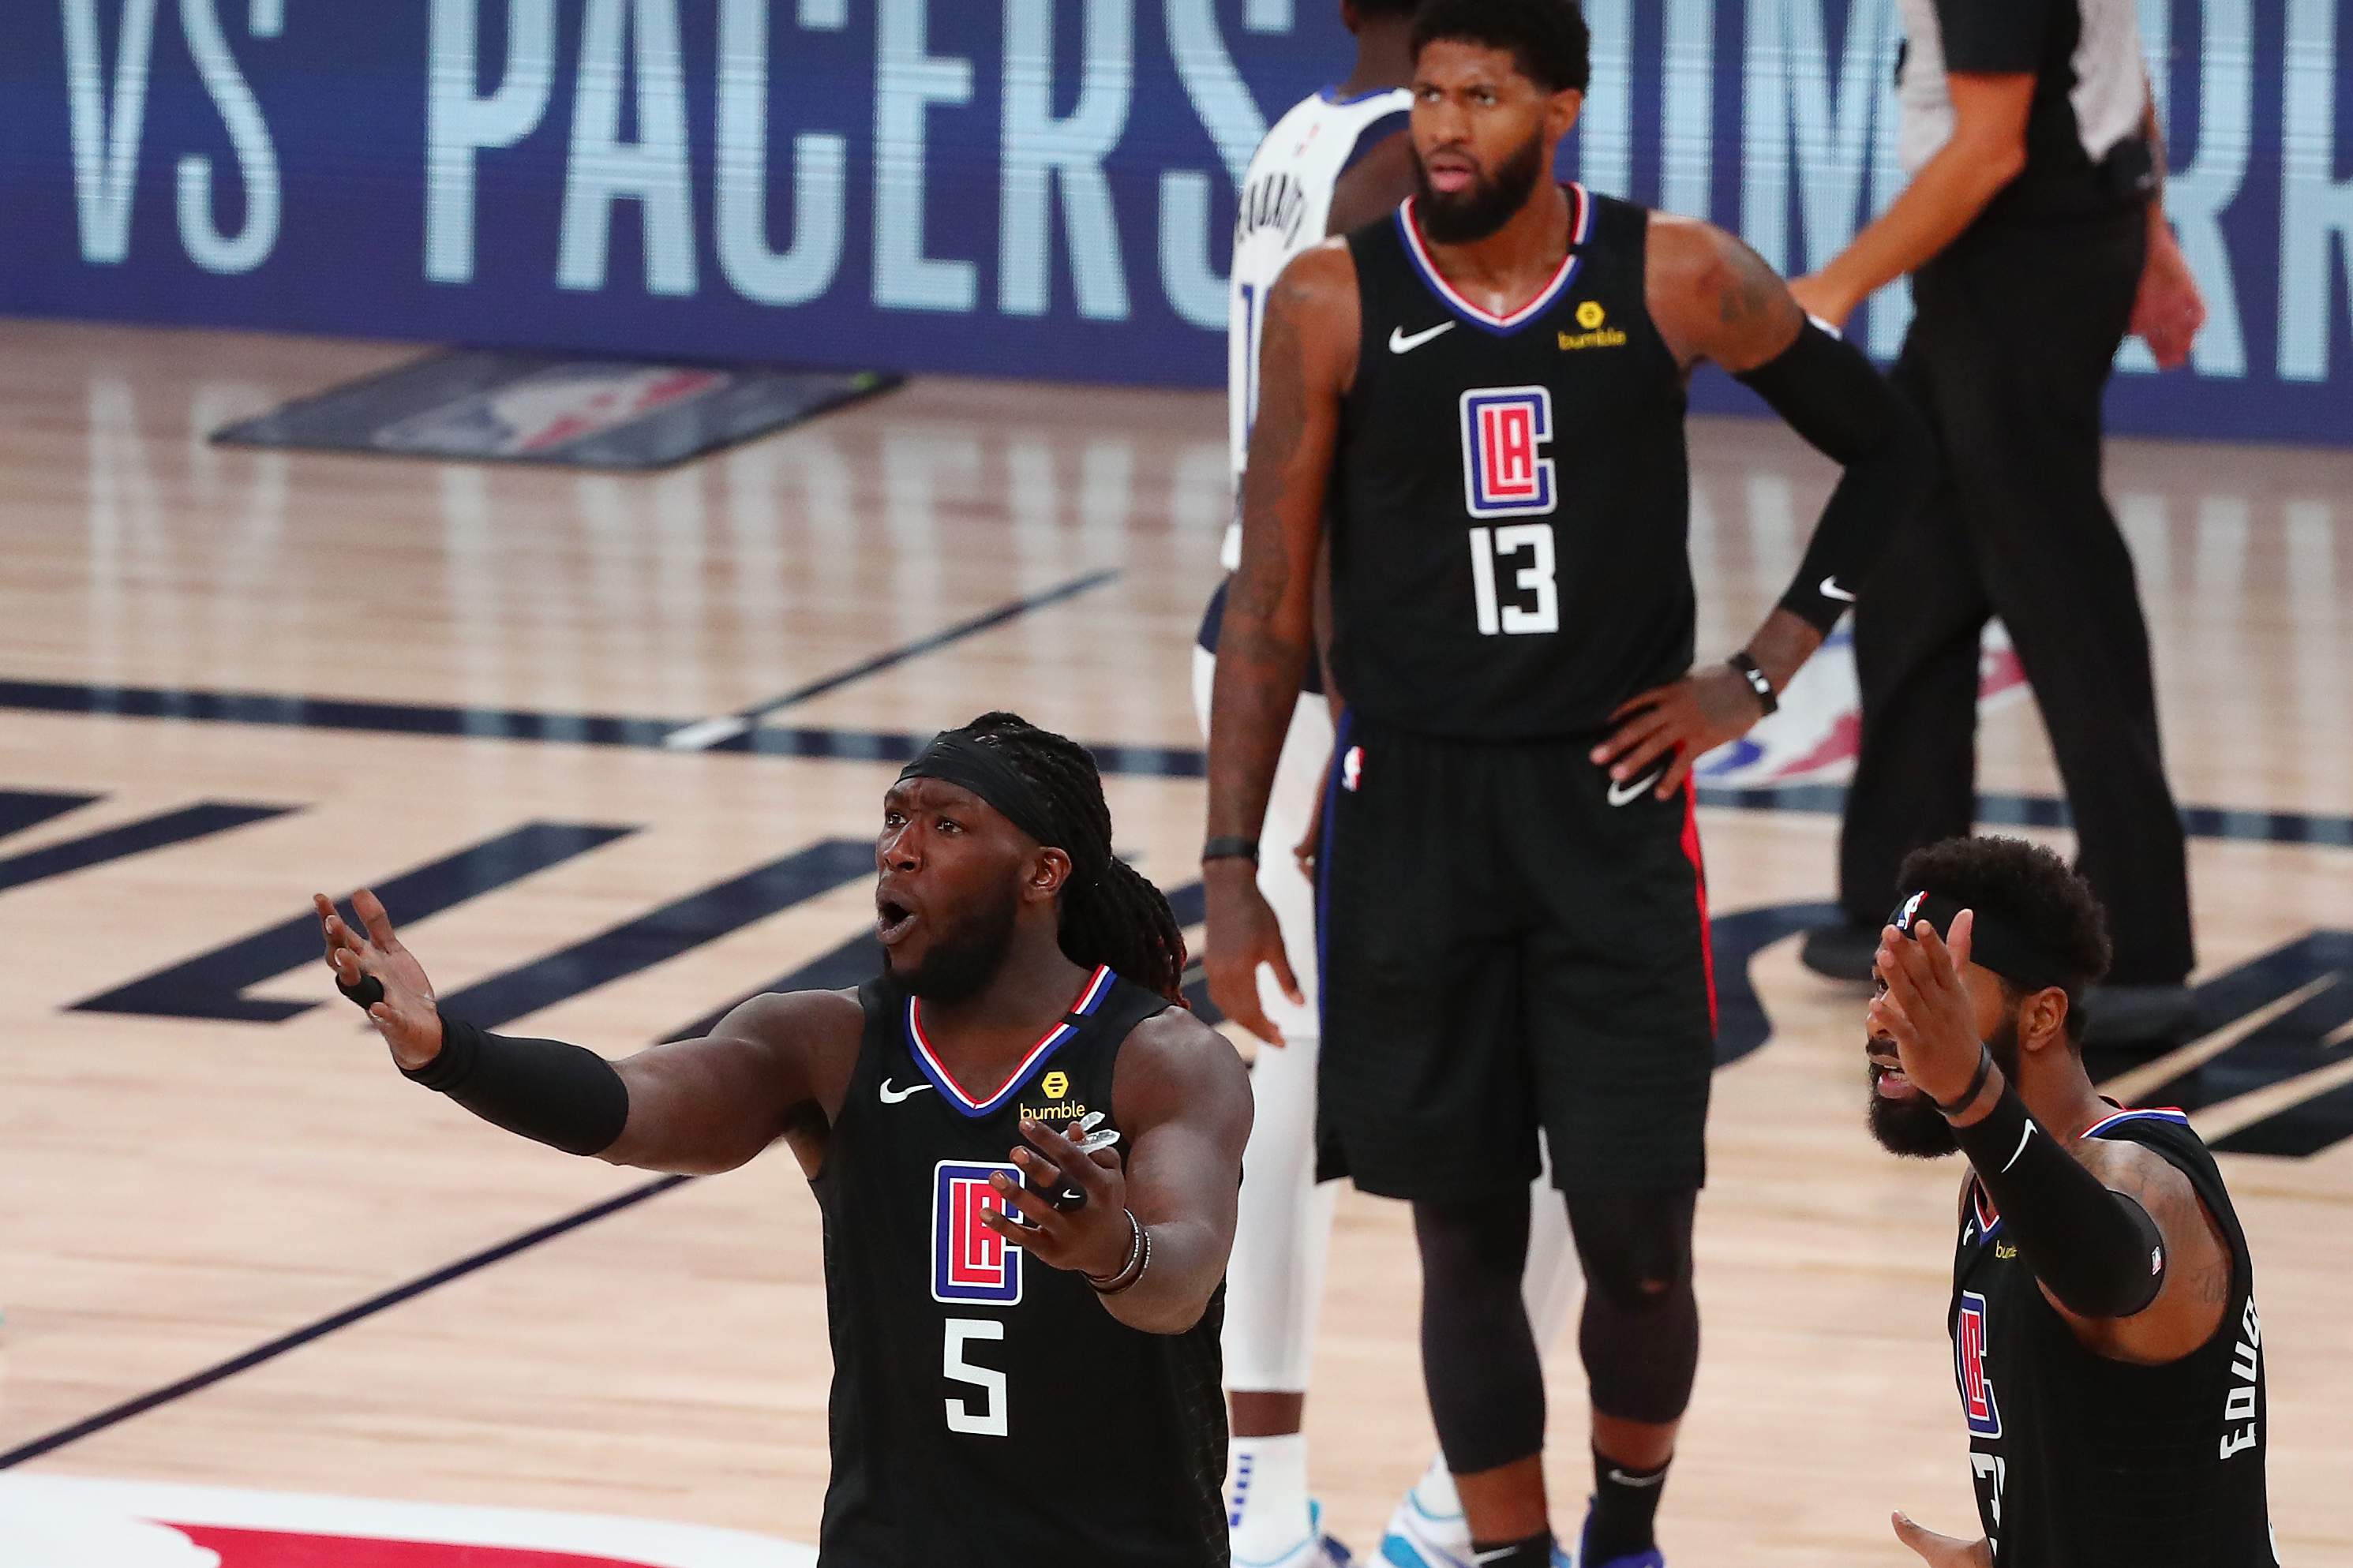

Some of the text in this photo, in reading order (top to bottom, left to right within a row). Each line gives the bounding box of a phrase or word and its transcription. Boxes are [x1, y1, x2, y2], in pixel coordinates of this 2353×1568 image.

[60, 0, 284, 275] VS
[424, 0, 1296, 331] PACERS
[1468, 522, 1560, 636] 13
[1019, 1100, 1086, 1121] bumble
[943, 1317, 1008, 1437] 5
